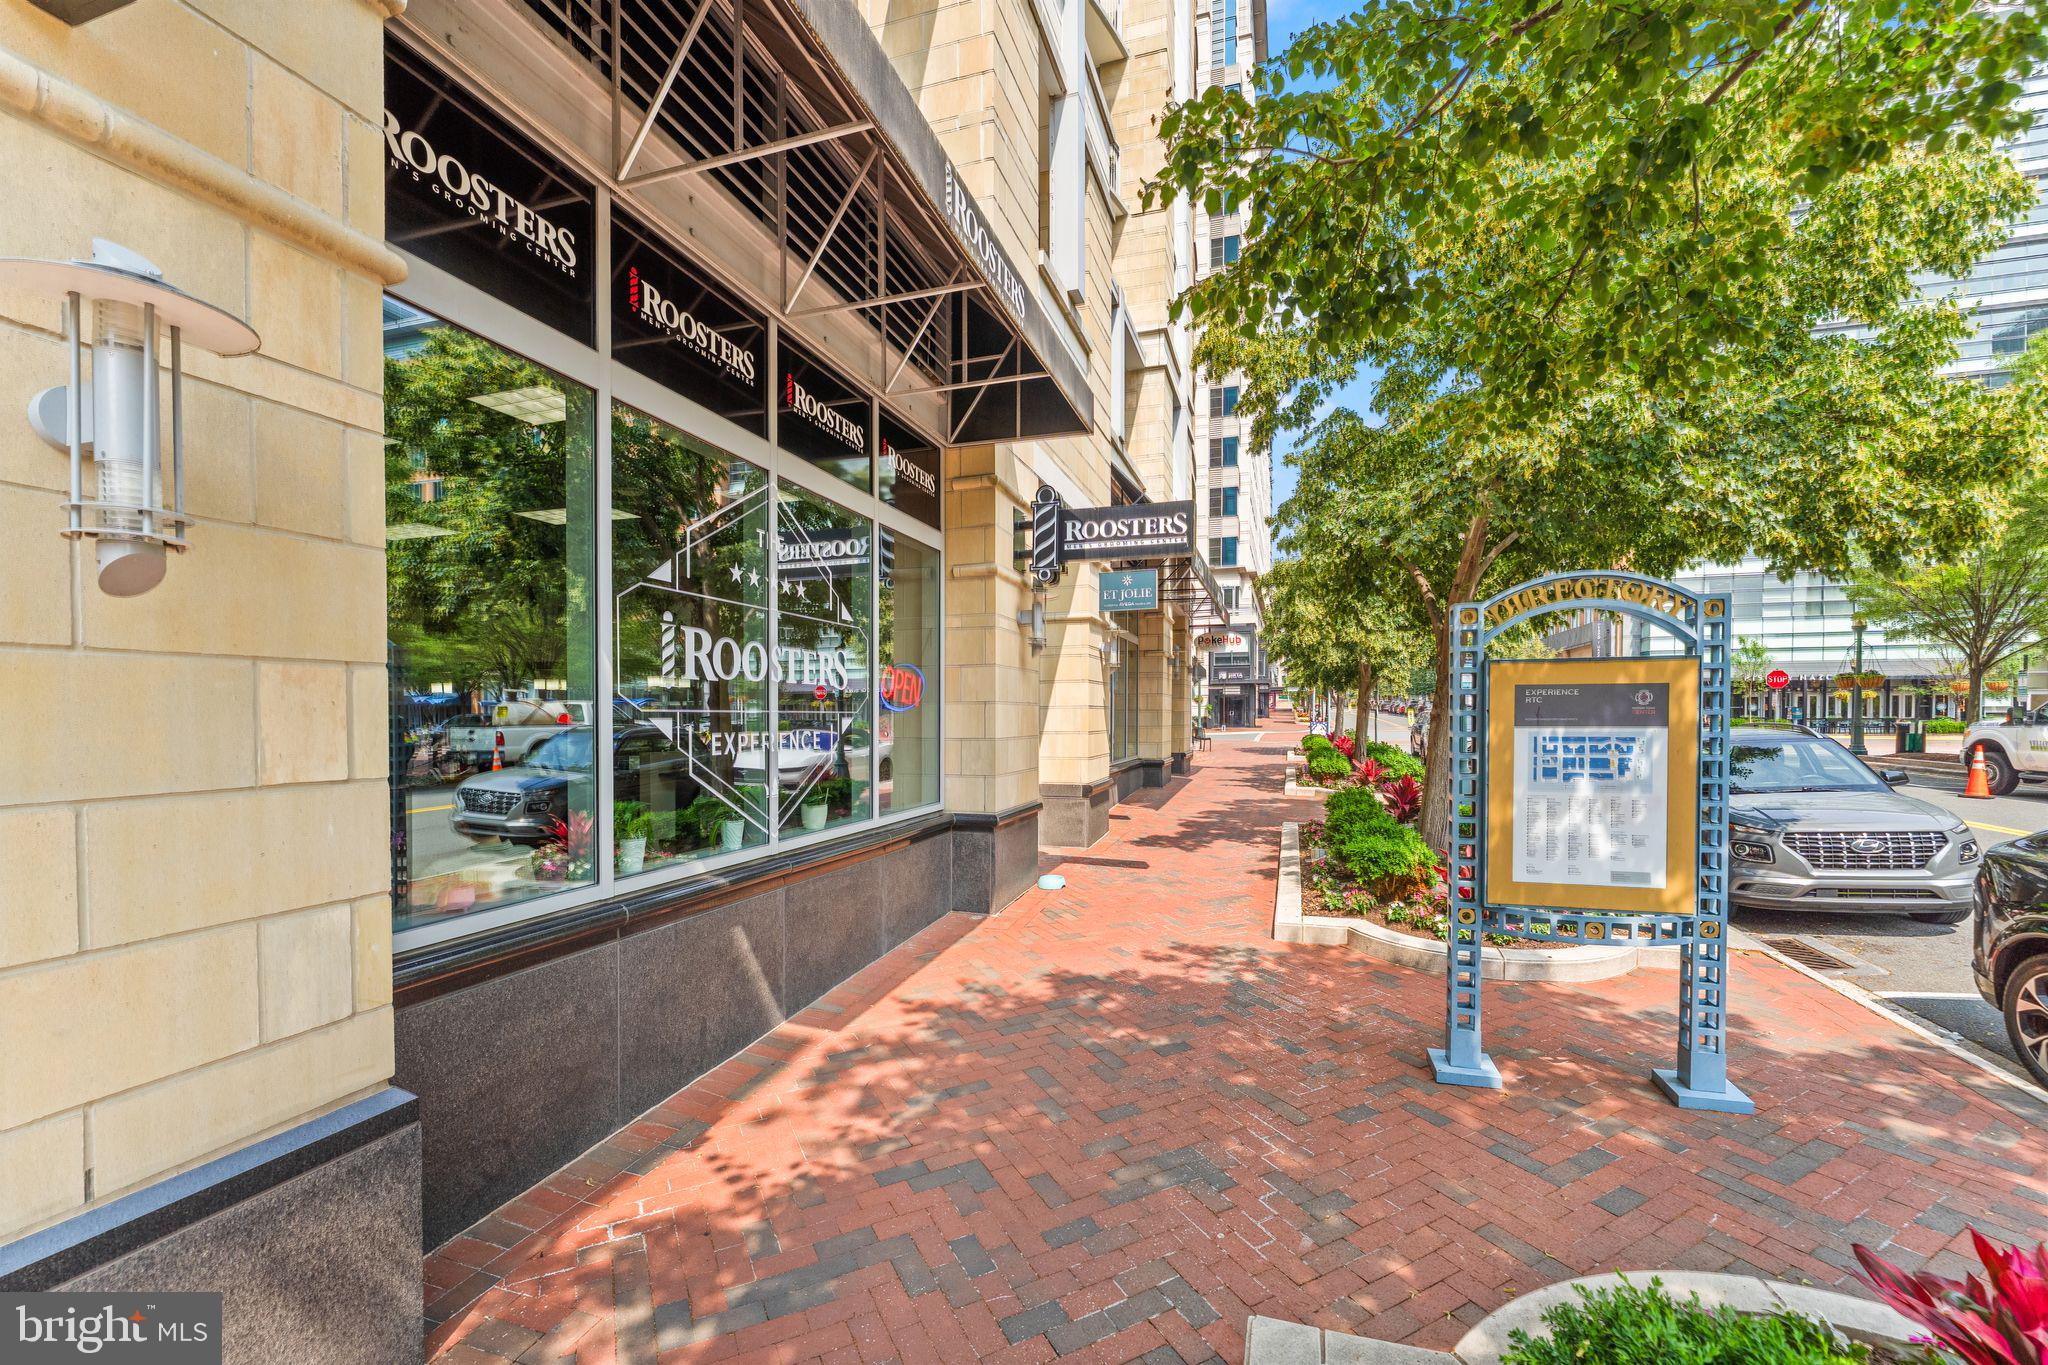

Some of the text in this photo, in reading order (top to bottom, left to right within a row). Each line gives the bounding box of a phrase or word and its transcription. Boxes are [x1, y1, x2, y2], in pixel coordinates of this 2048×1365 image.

[384, 107, 577, 268] ROOSTERS
[431, 183, 517, 242] GROOMING
[526, 242, 576, 278] CENTER
[953, 178, 1025, 319] ROOSTERS
[640, 312, 755, 388] MEN'S GROOMING CENTER
[641, 279, 755, 380] ROOSTERS
[793, 381, 864, 449] ROOSTERS
[886, 444, 935, 493] ROOSTERS
[1064, 511, 1188, 542] ROOSTERS
[1103, 587, 1153, 602] ET JOLIE
[1484, 577, 1694, 625] DIRECTORY
[680, 624, 849, 691] ROOSTERS
[1197, 634, 1242, 647] PokeHub
[881, 664, 922, 708] OPEN
[1525, 688, 1580, 696] EXPERIENCE
[1525, 696, 1543, 704] RTC
[1767, 675, 1788, 684] STOP
[711, 729, 822, 757] EXPERIENCE
